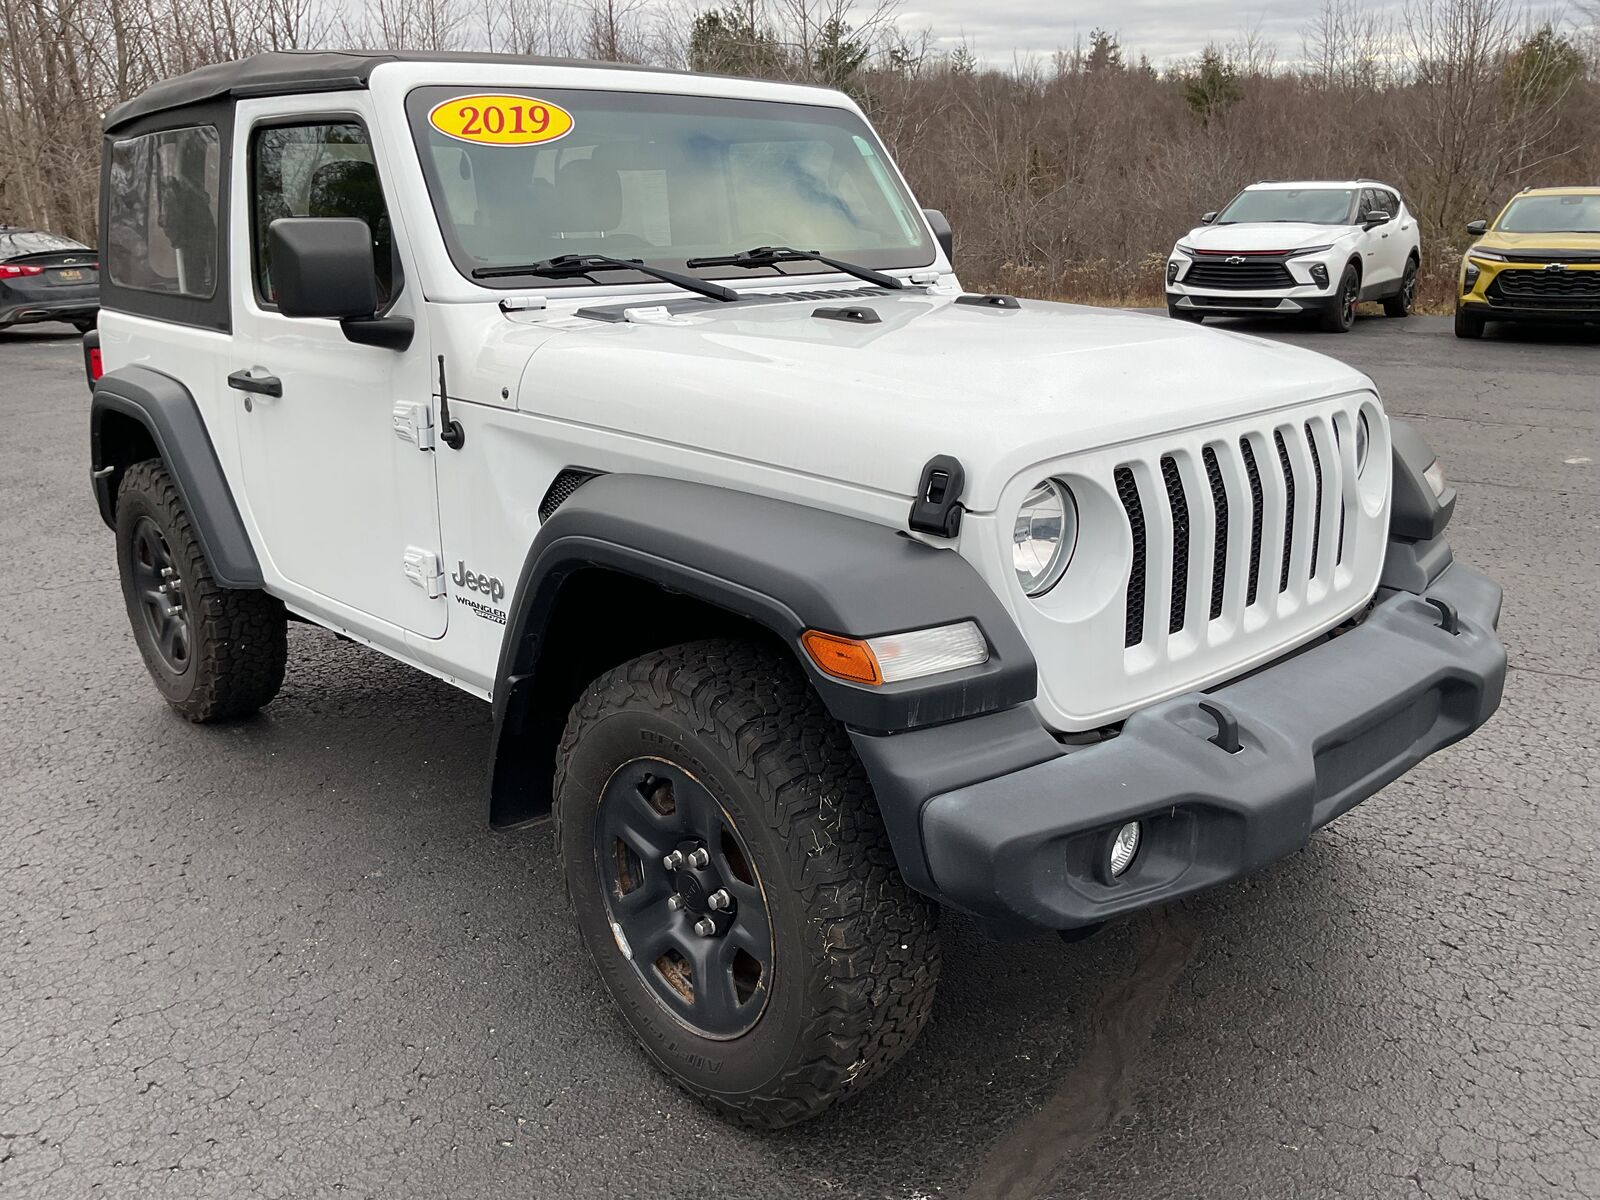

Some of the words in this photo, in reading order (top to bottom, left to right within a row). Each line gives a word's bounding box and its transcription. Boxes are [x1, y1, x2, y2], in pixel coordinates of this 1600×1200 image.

[459, 106, 550, 134] 2019
[452, 560, 504, 603] Jeep
[455, 595, 506, 619] WRANGLER
